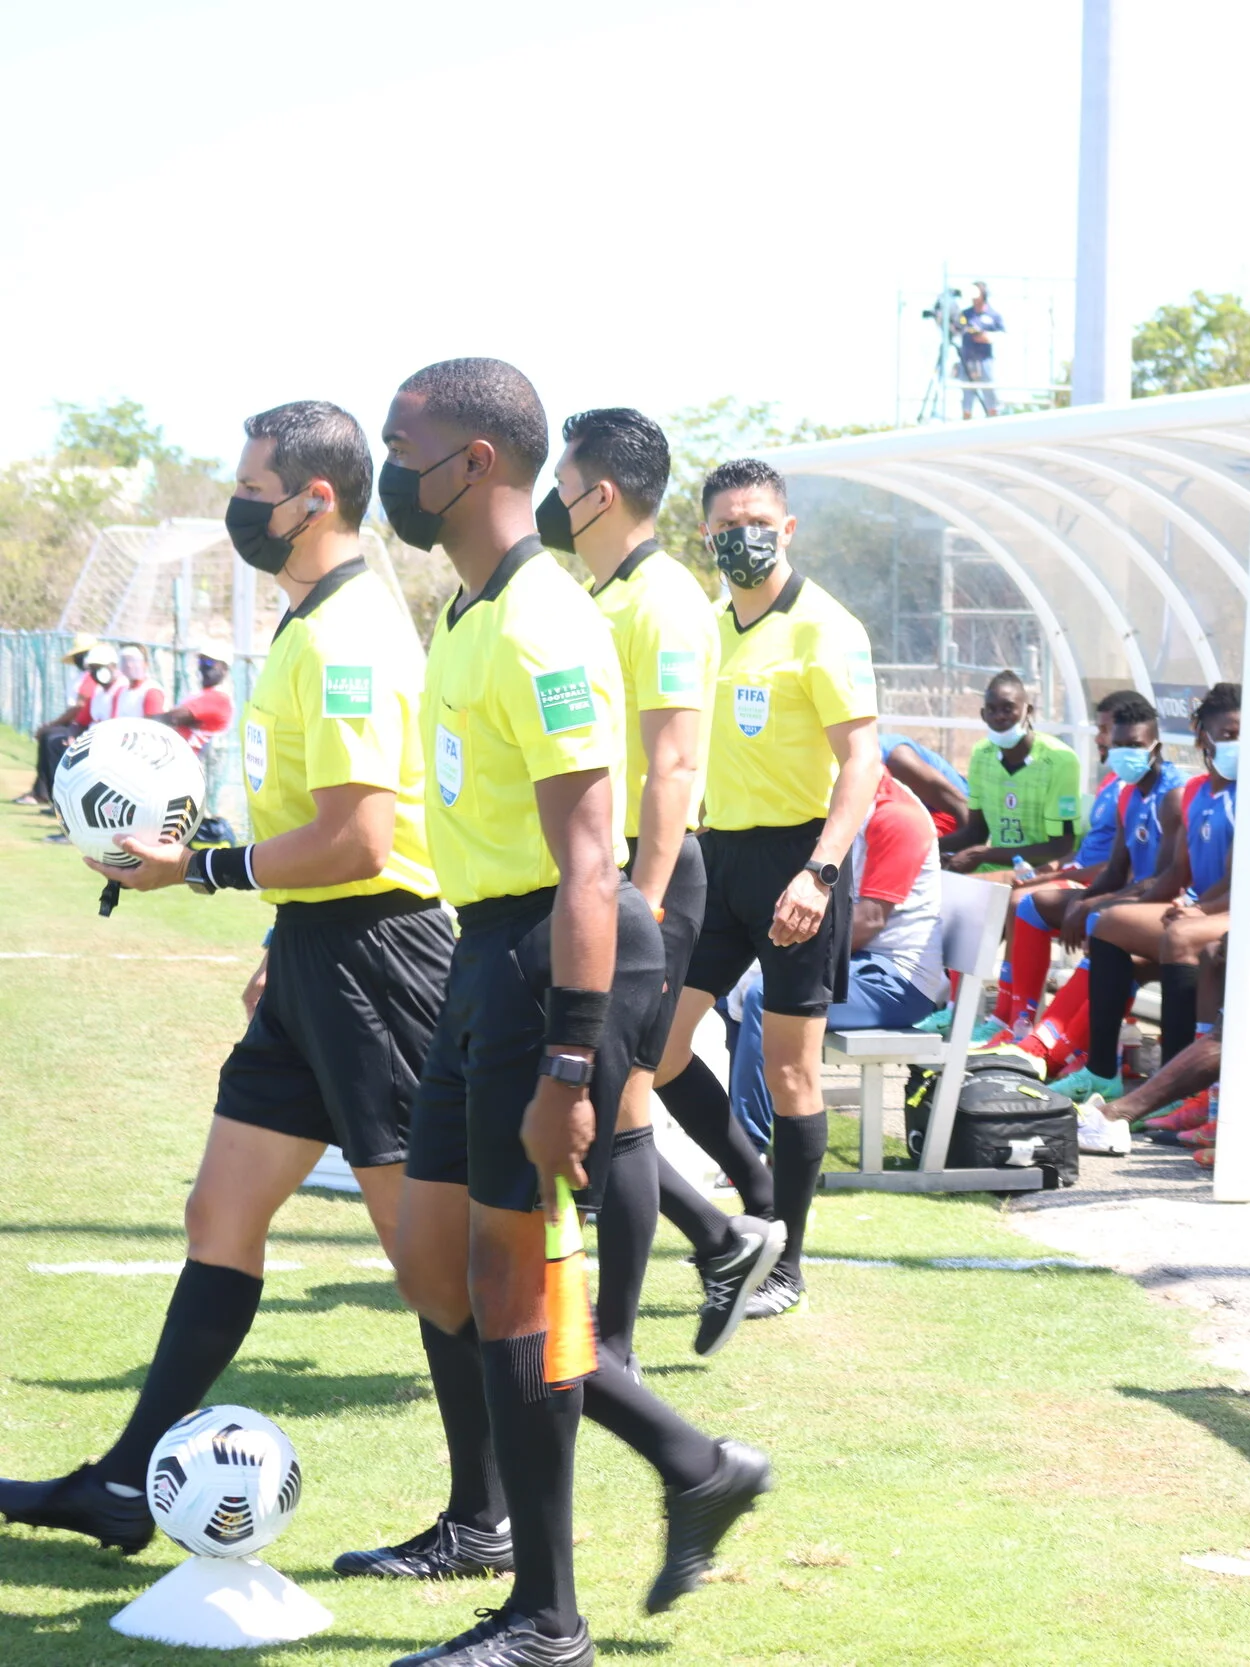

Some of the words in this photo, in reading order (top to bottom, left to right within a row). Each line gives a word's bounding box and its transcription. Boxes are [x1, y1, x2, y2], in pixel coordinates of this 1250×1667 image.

[738, 689, 765, 702] FIFA
[247, 724, 262, 744] FIFA
[1001, 818, 1024, 843] 23
